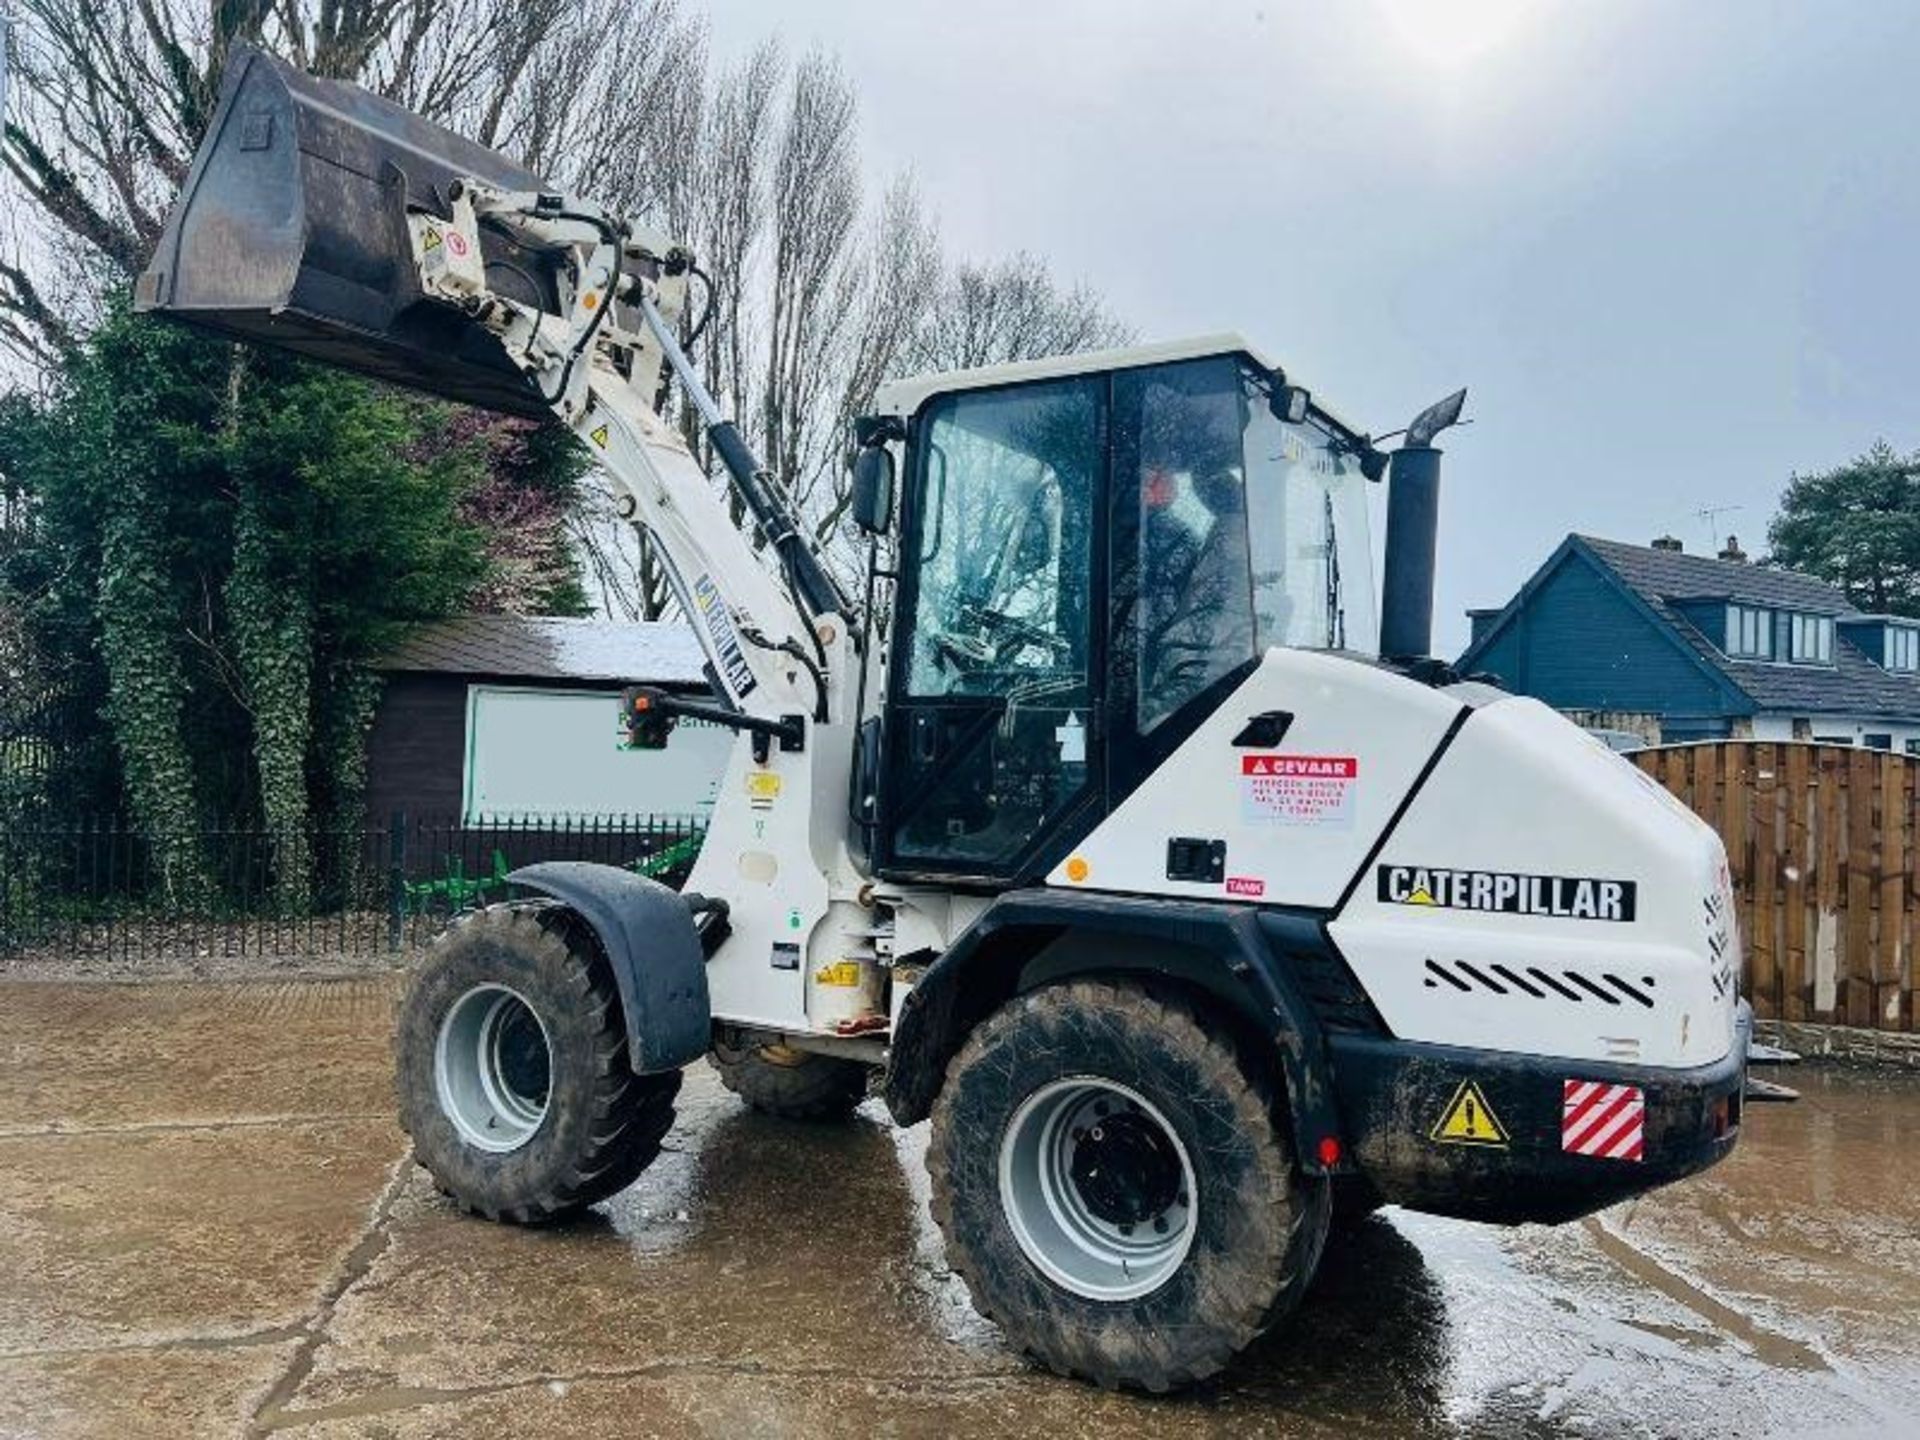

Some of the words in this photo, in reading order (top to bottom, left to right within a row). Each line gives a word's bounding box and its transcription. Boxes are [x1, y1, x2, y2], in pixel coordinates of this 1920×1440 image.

[698, 579, 753, 693] CATERPILLAR
[1273, 759, 1347, 775] GEVAAR
[1227, 880, 1262, 894] TANK
[1389, 867, 1623, 921] CATERPILLAR
